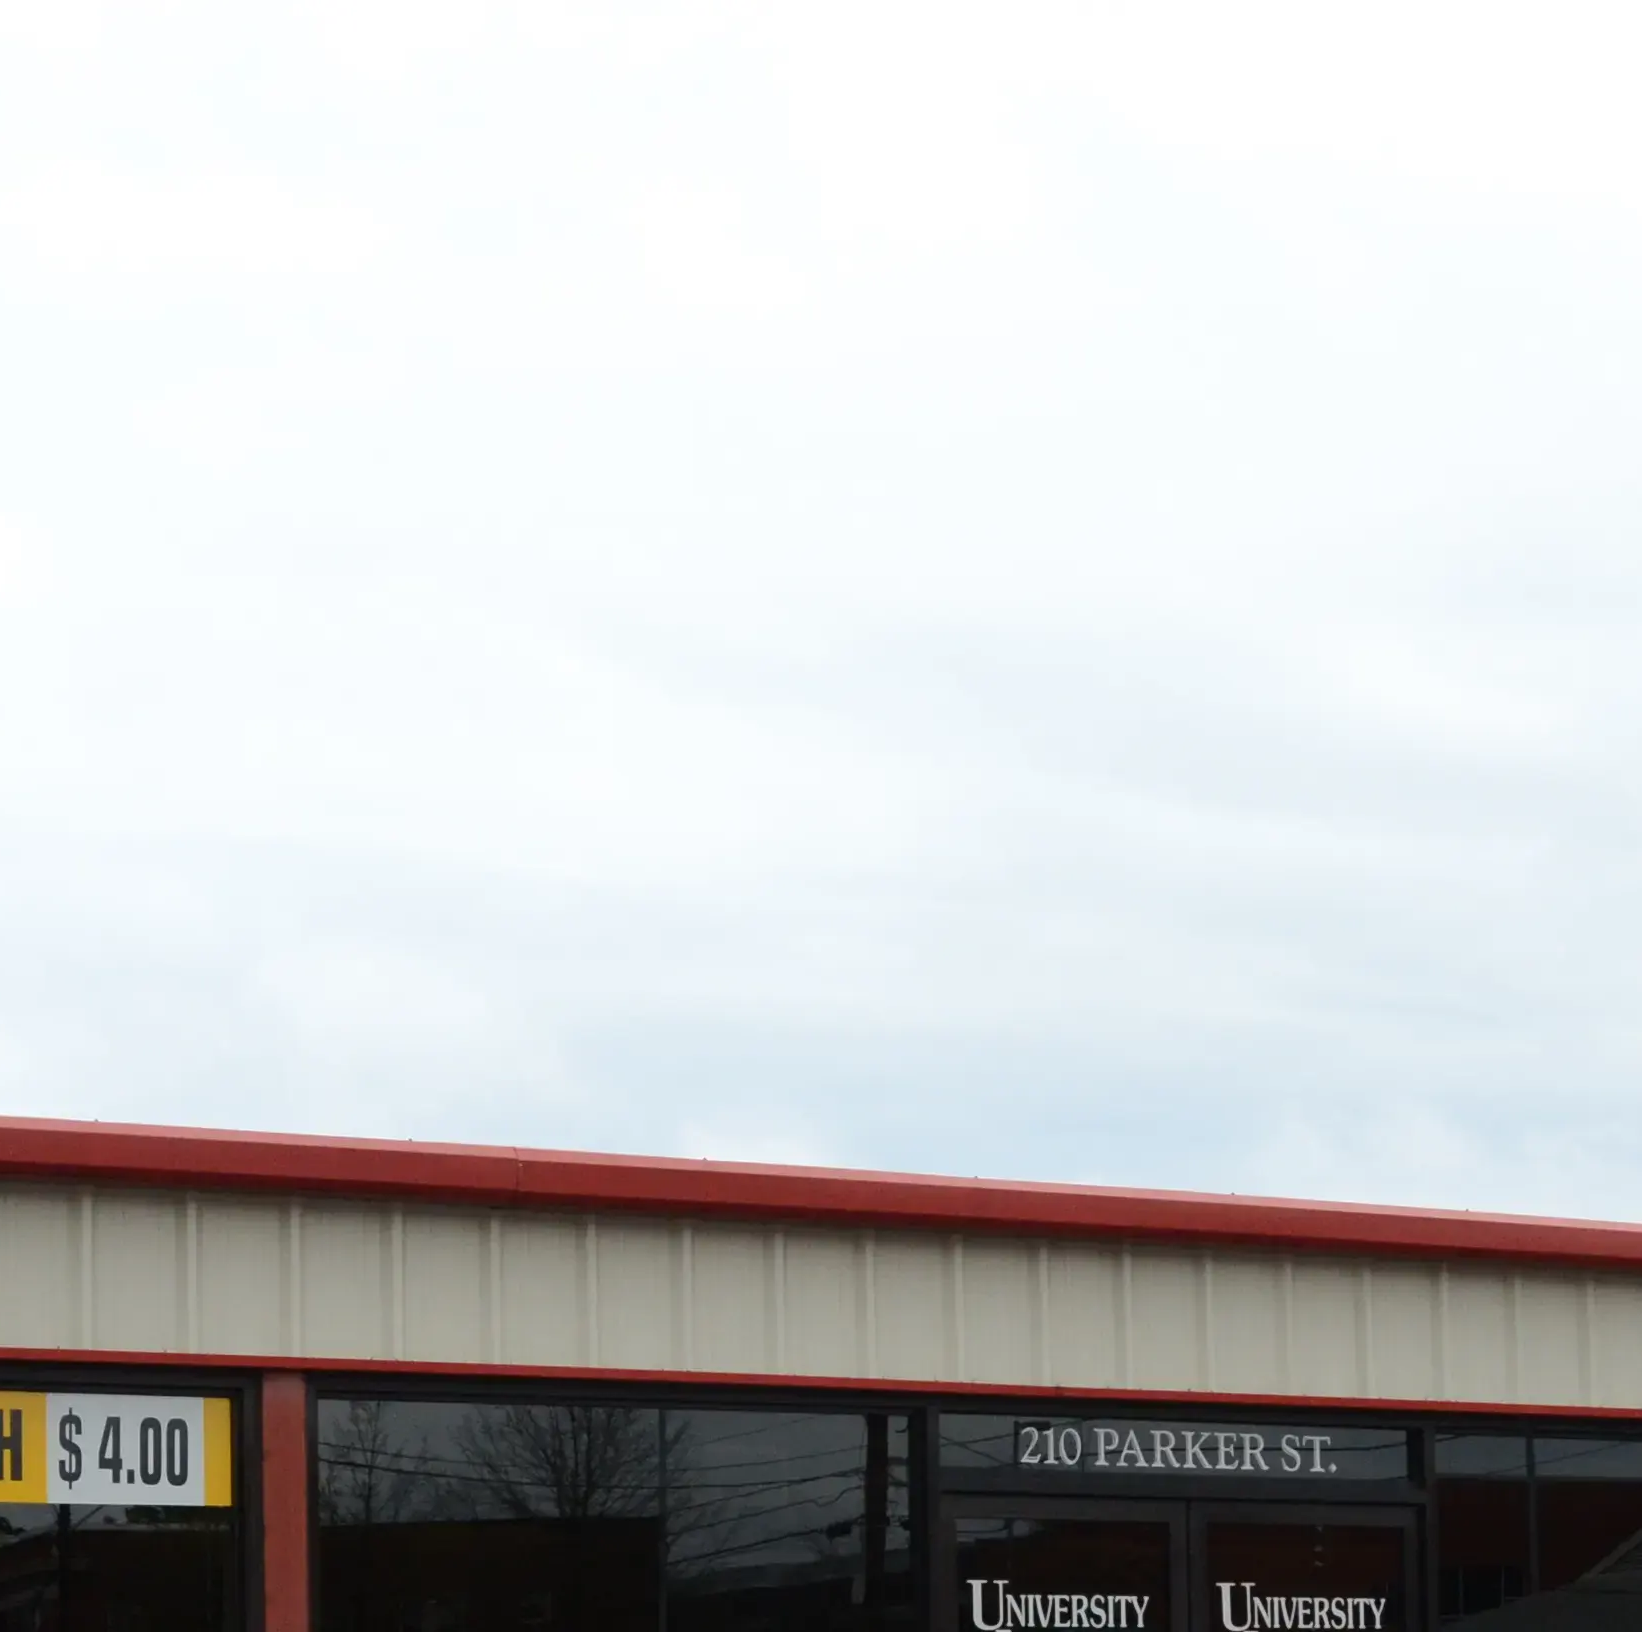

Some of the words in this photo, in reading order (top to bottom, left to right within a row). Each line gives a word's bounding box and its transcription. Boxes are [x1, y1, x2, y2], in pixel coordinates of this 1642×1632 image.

[1020, 1426, 1082, 1466] 210
[1093, 1427, 1270, 1472] PARKER
[1280, 1434, 1338, 1474] ST.
[966, 1579, 1149, 1632] UNIVERSITY
[1216, 1582, 1386, 1632] UNIVERSITY
